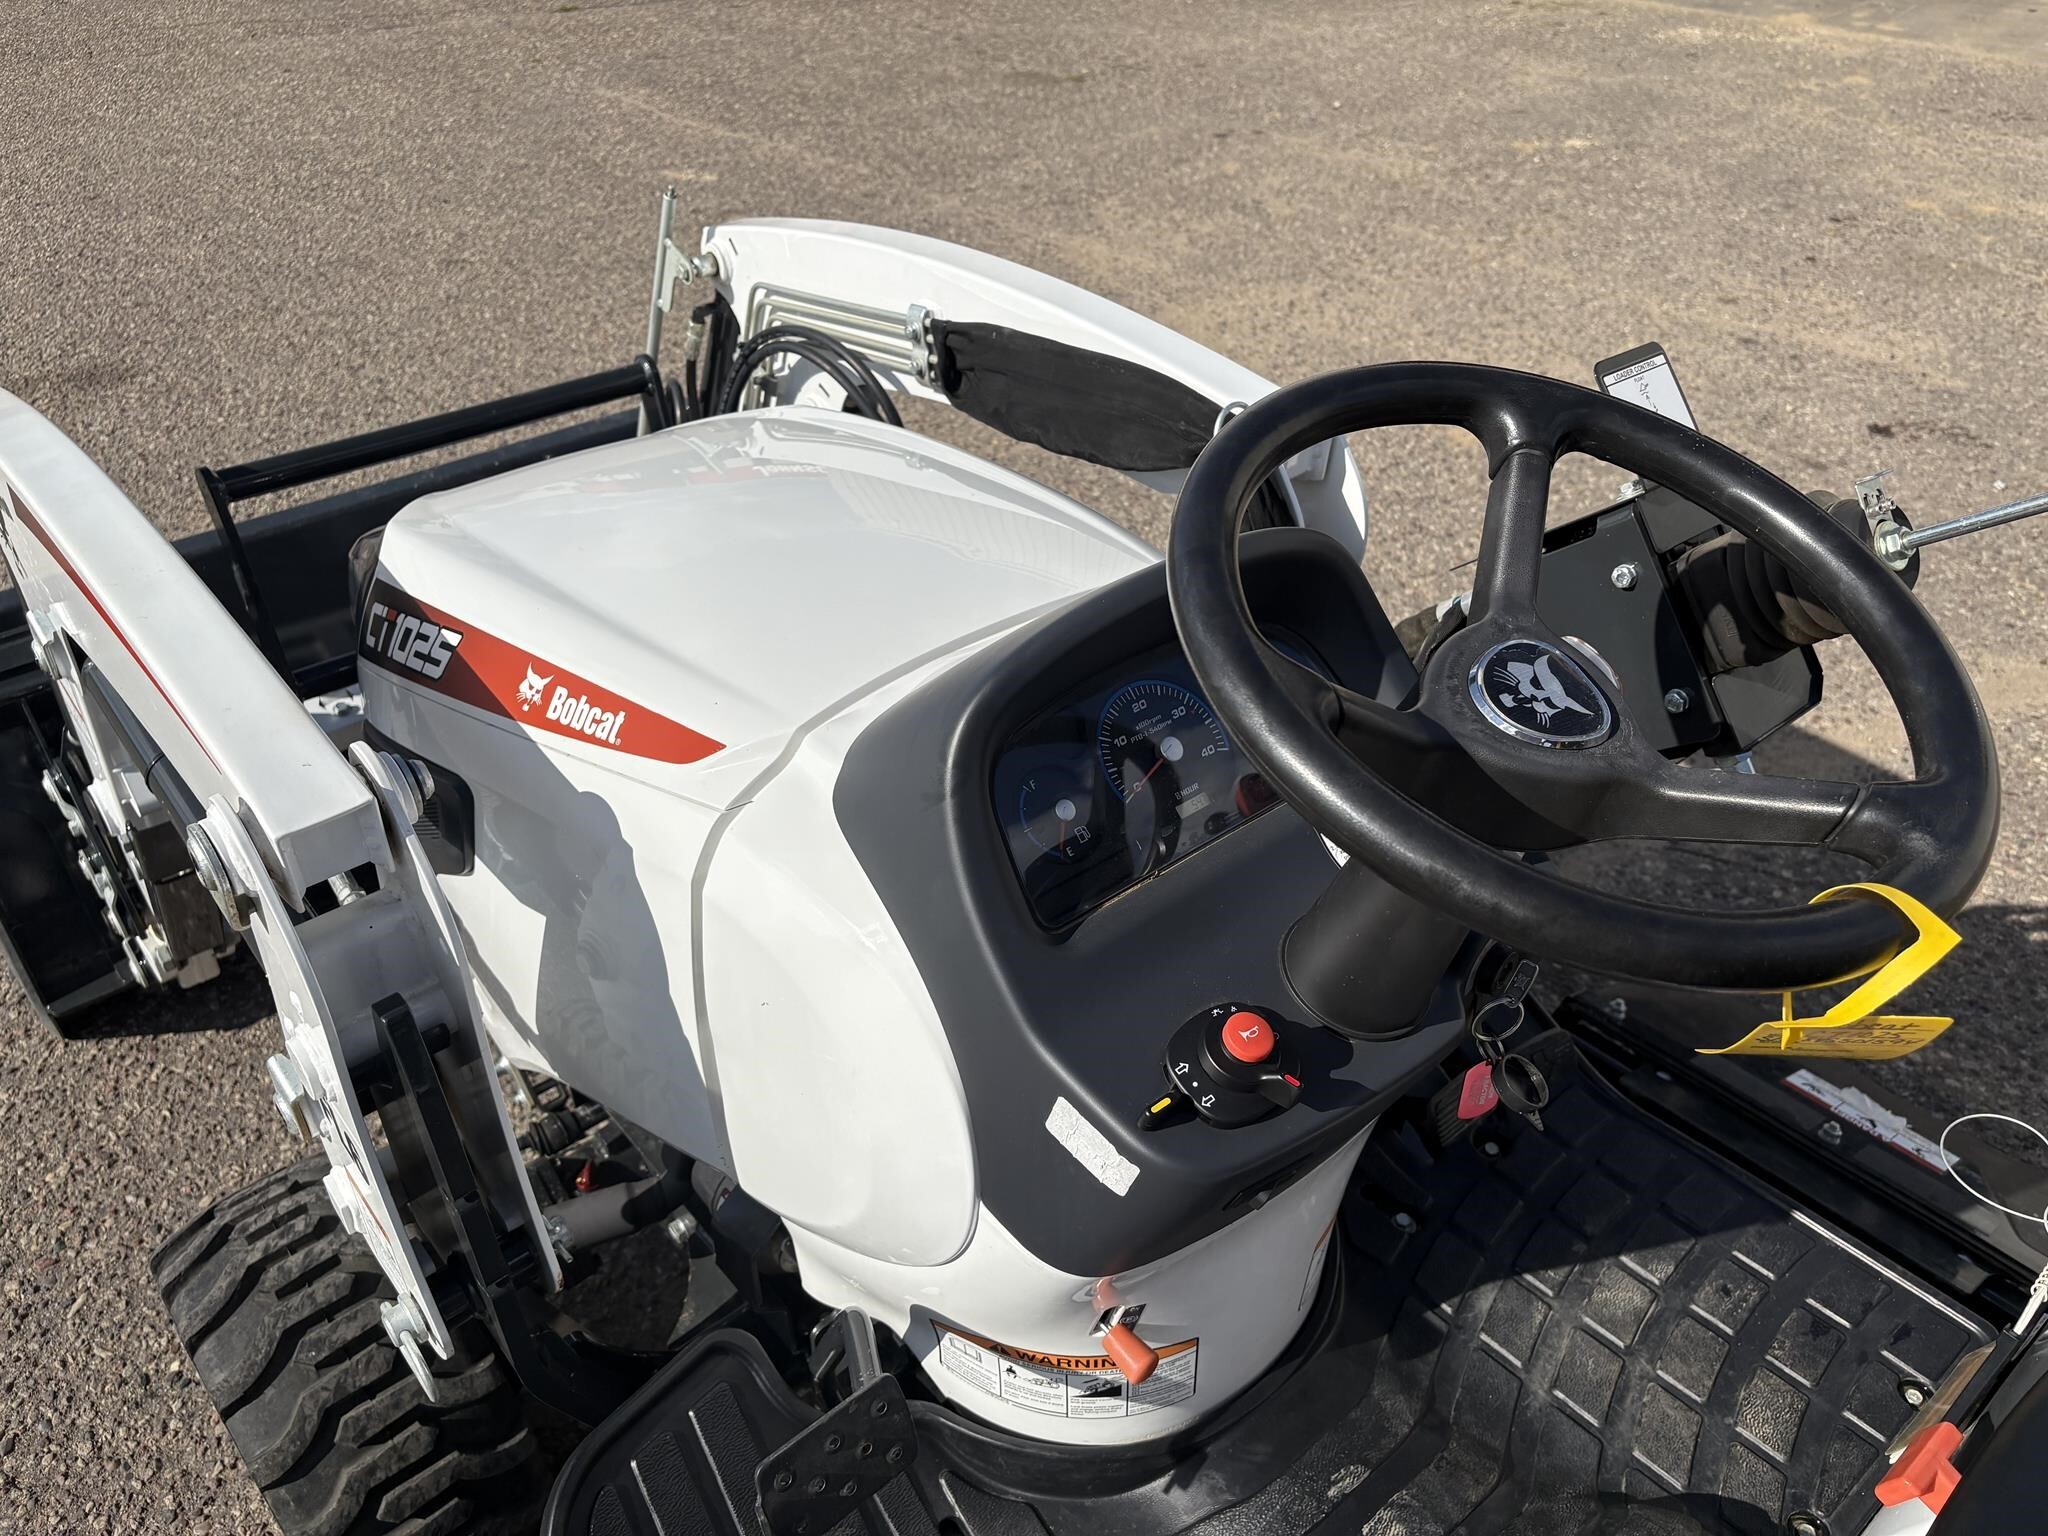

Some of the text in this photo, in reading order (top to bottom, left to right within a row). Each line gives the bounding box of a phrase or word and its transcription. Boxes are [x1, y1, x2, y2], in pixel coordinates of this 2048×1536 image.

[1613, 360, 1657, 381] LOADER CONTROL
[1131, 700, 1147, 712] 20
[545, 685, 626, 744] Bobcat
[1171, 706, 1186, 719] 30
[1113, 735, 1127, 747] 10
[1201, 745, 1215, 757] 40
[1029, 780, 1036, 790] F
[1180, 782, 1199, 797] HOUR
[1066, 846, 1074, 857] E
[1015, 1350, 1117, 1368] WARNIN
